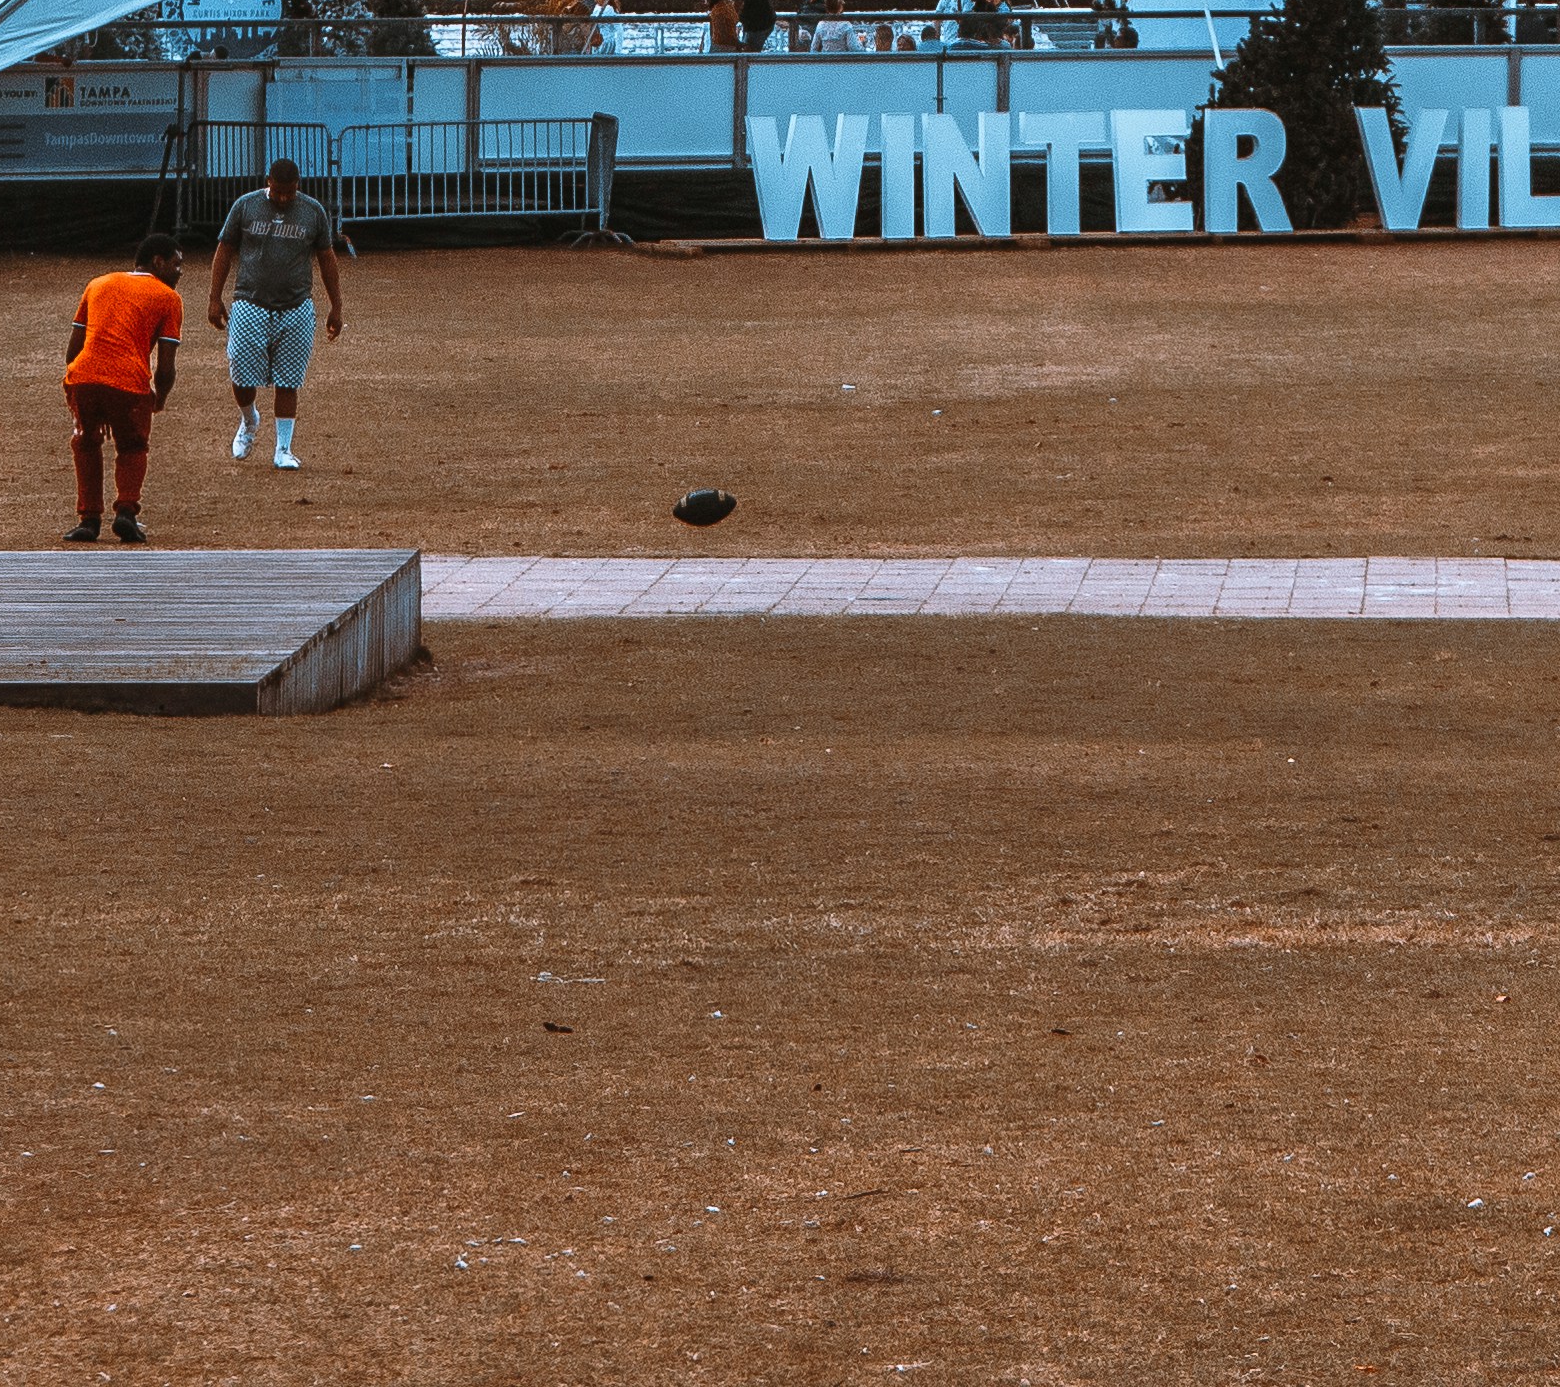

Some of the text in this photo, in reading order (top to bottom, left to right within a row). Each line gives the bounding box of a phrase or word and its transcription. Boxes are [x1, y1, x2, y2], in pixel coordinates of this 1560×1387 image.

[4, 90, 23, 98] YOU
[80, 86, 131, 98] TAMPA
[45, 131, 167, 148] TampasDowntown.c
[745, 107, 1294, 241] WINTER
